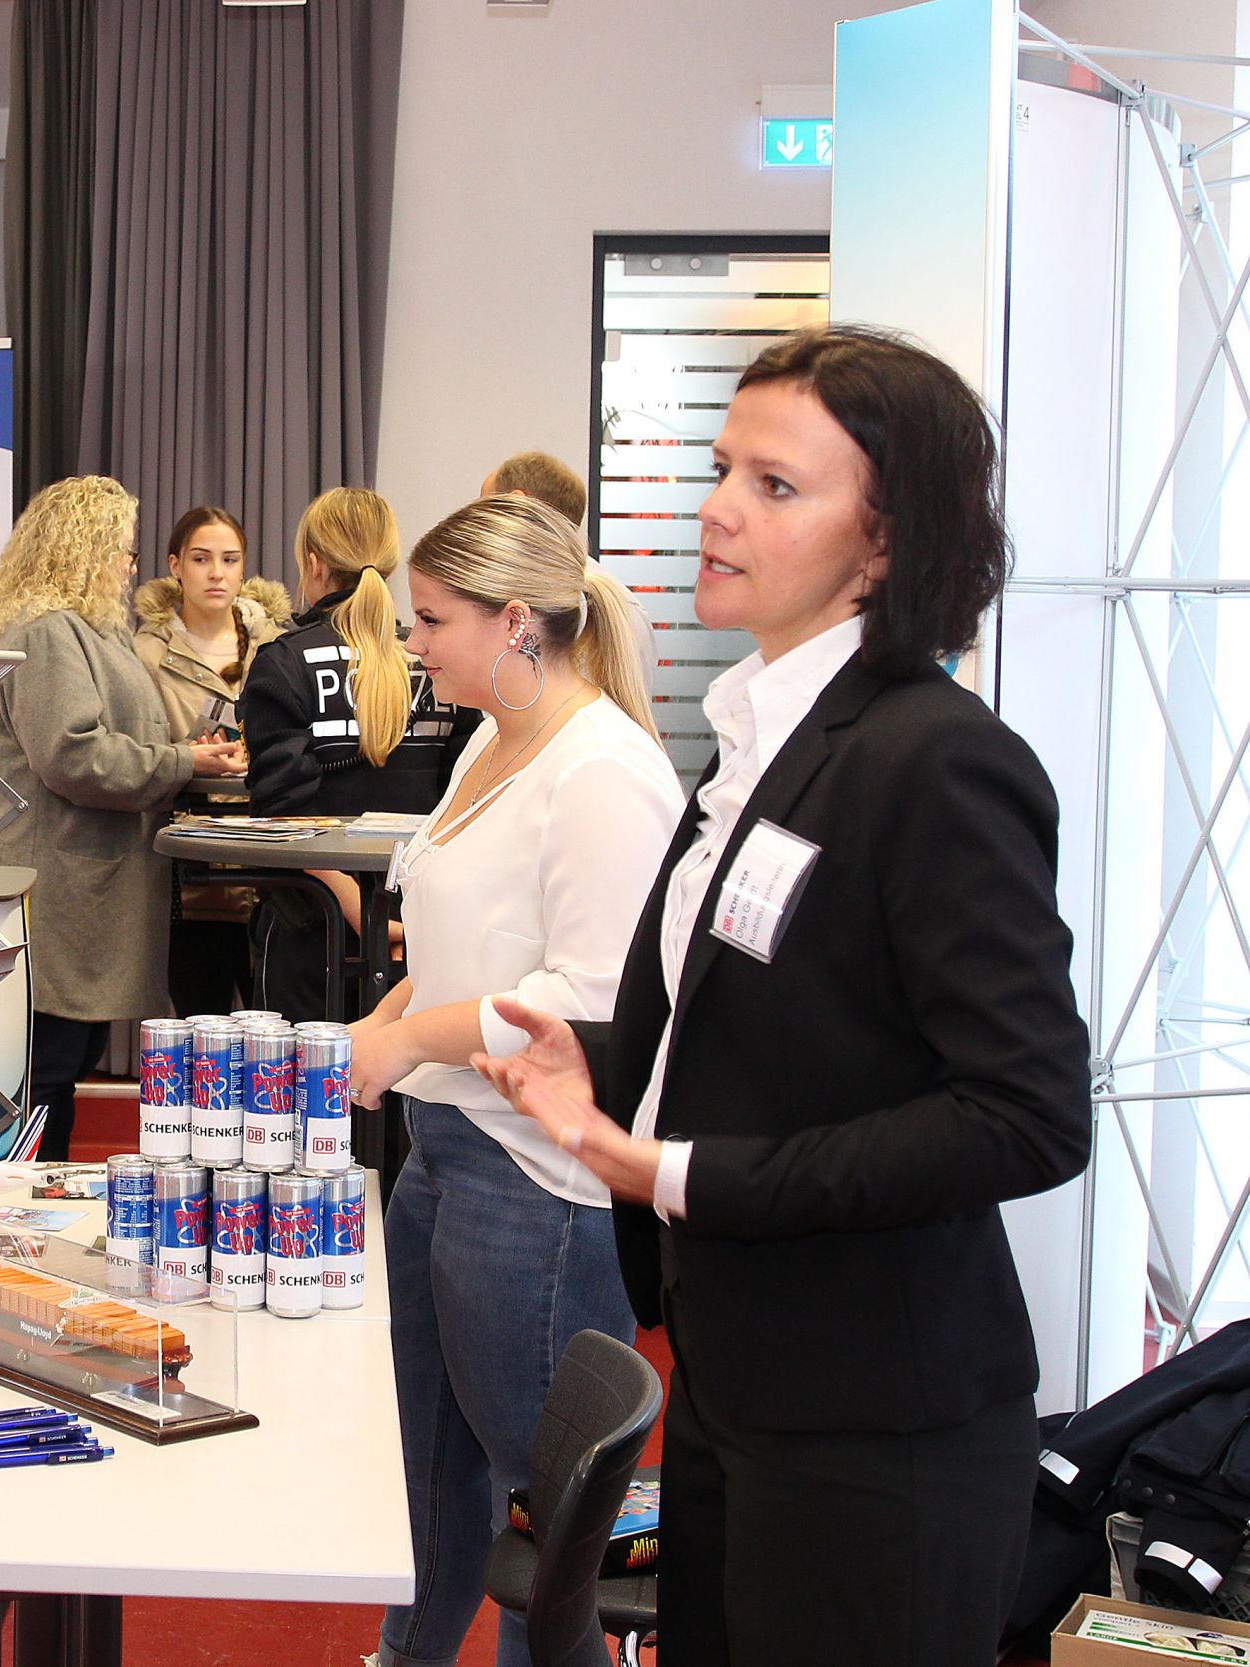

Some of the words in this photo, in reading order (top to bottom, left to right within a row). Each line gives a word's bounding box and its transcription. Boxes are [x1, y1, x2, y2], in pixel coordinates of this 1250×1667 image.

[730, 870, 750, 914] SCHEKER
[736, 916, 748, 939] Olga
[247, 1128, 264, 1142] DB
[314, 1139, 335, 1152] DB
[230, 1232, 254, 1255] Up
[280, 1235, 305, 1259] Up
[165, 1263, 185, 1276] DB
[324, 1273, 344, 1286] DB
